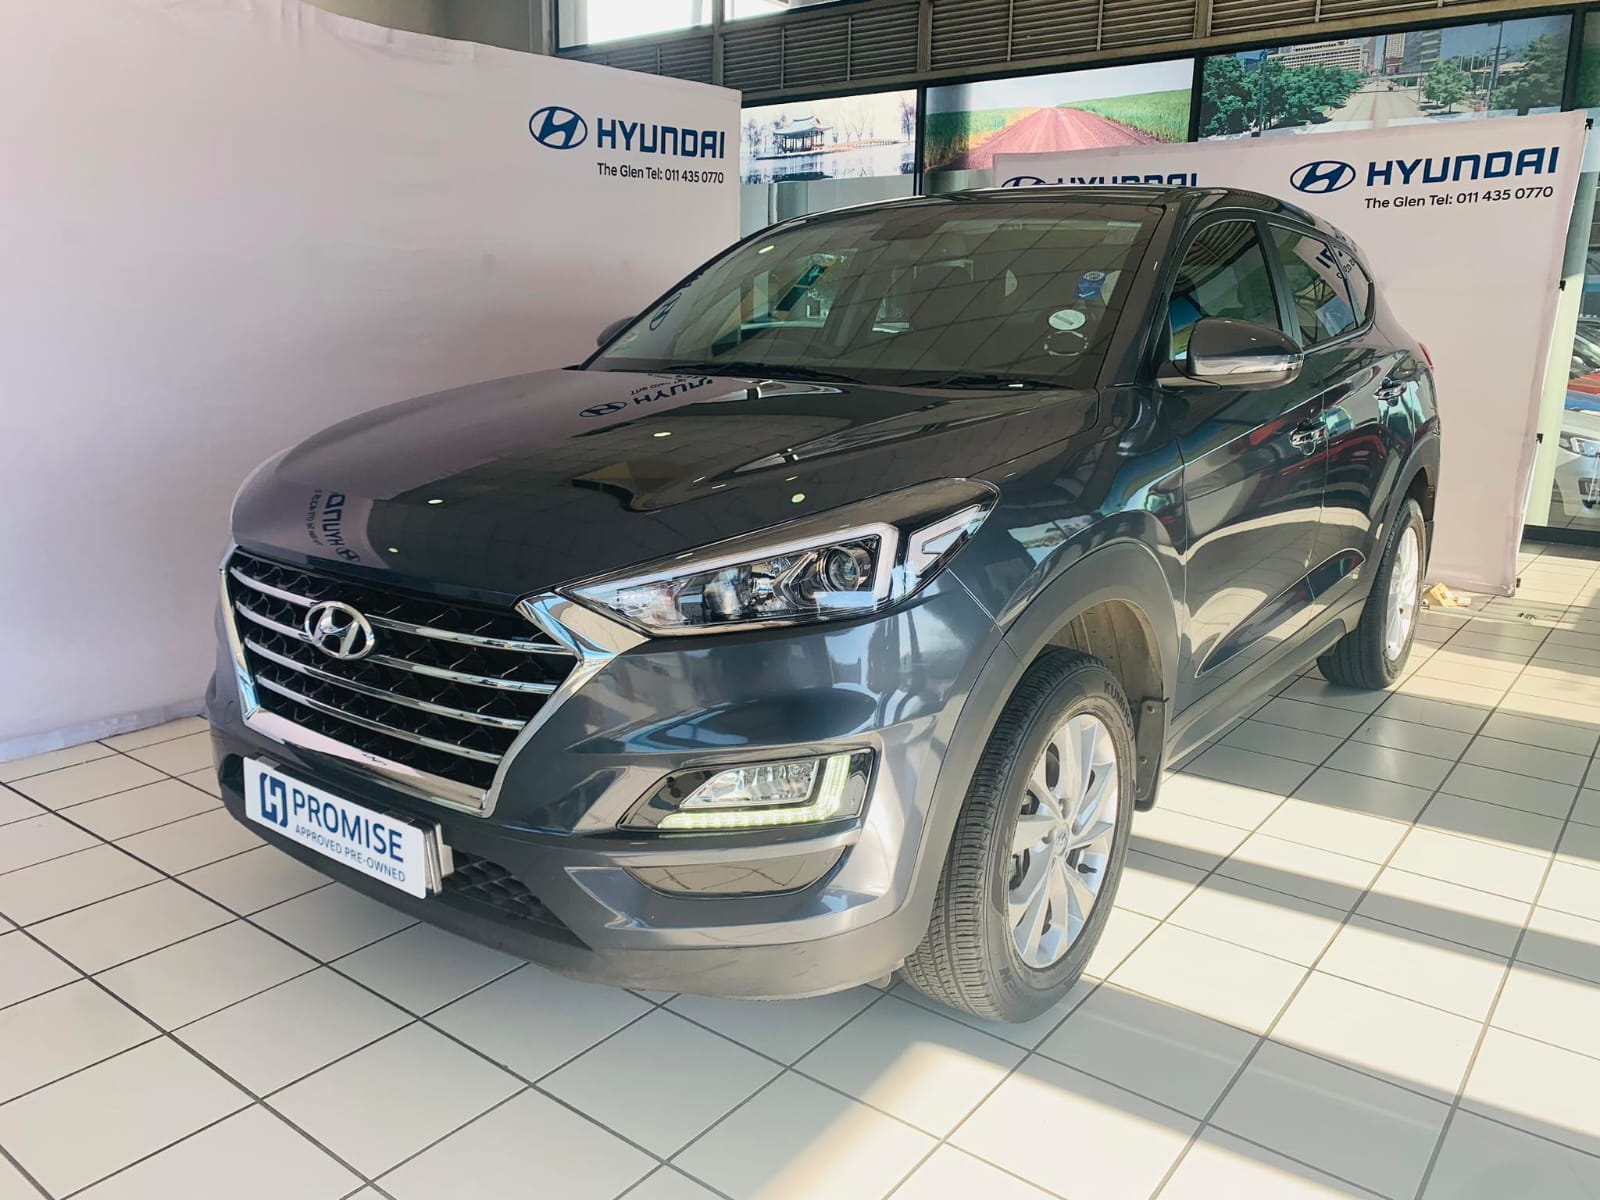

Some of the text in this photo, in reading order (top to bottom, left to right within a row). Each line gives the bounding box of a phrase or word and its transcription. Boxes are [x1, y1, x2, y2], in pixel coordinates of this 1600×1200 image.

[597, 117, 725, 159] HYUNDAI
[597, 162, 724, 184] The Glen Tel: 011 435 0770
[1366, 146, 1560, 187] HYUNDAI
[1365, 186, 1554, 209] The Glen Tel: 011 435 0770
[292, 787, 404, 863] PROMISE
[295, 824, 406, 883] APPROVED PRE-OWNED
